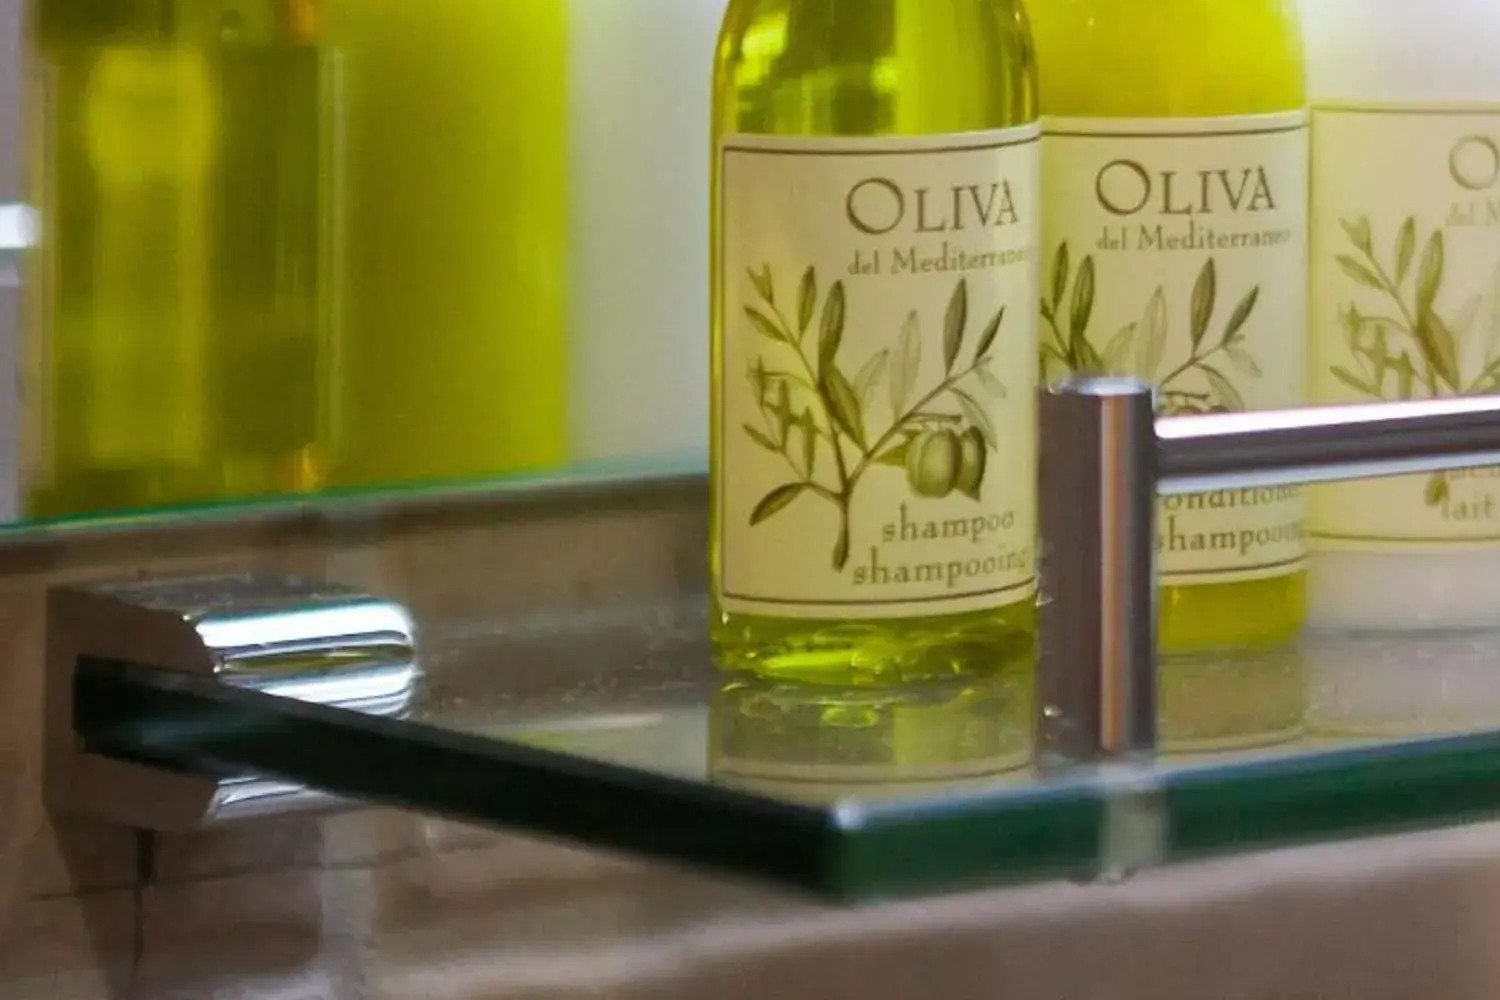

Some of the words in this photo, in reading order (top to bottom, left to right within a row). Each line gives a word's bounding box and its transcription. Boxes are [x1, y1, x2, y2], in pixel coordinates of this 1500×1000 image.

[846, 176, 1020, 235] OLIVA
[1095, 159, 1276, 215] OLIVA
[1097, 226, 1127, 250] del
[848, 248, 880, 275] del
[882, 501, 1015, 542] shampoo
